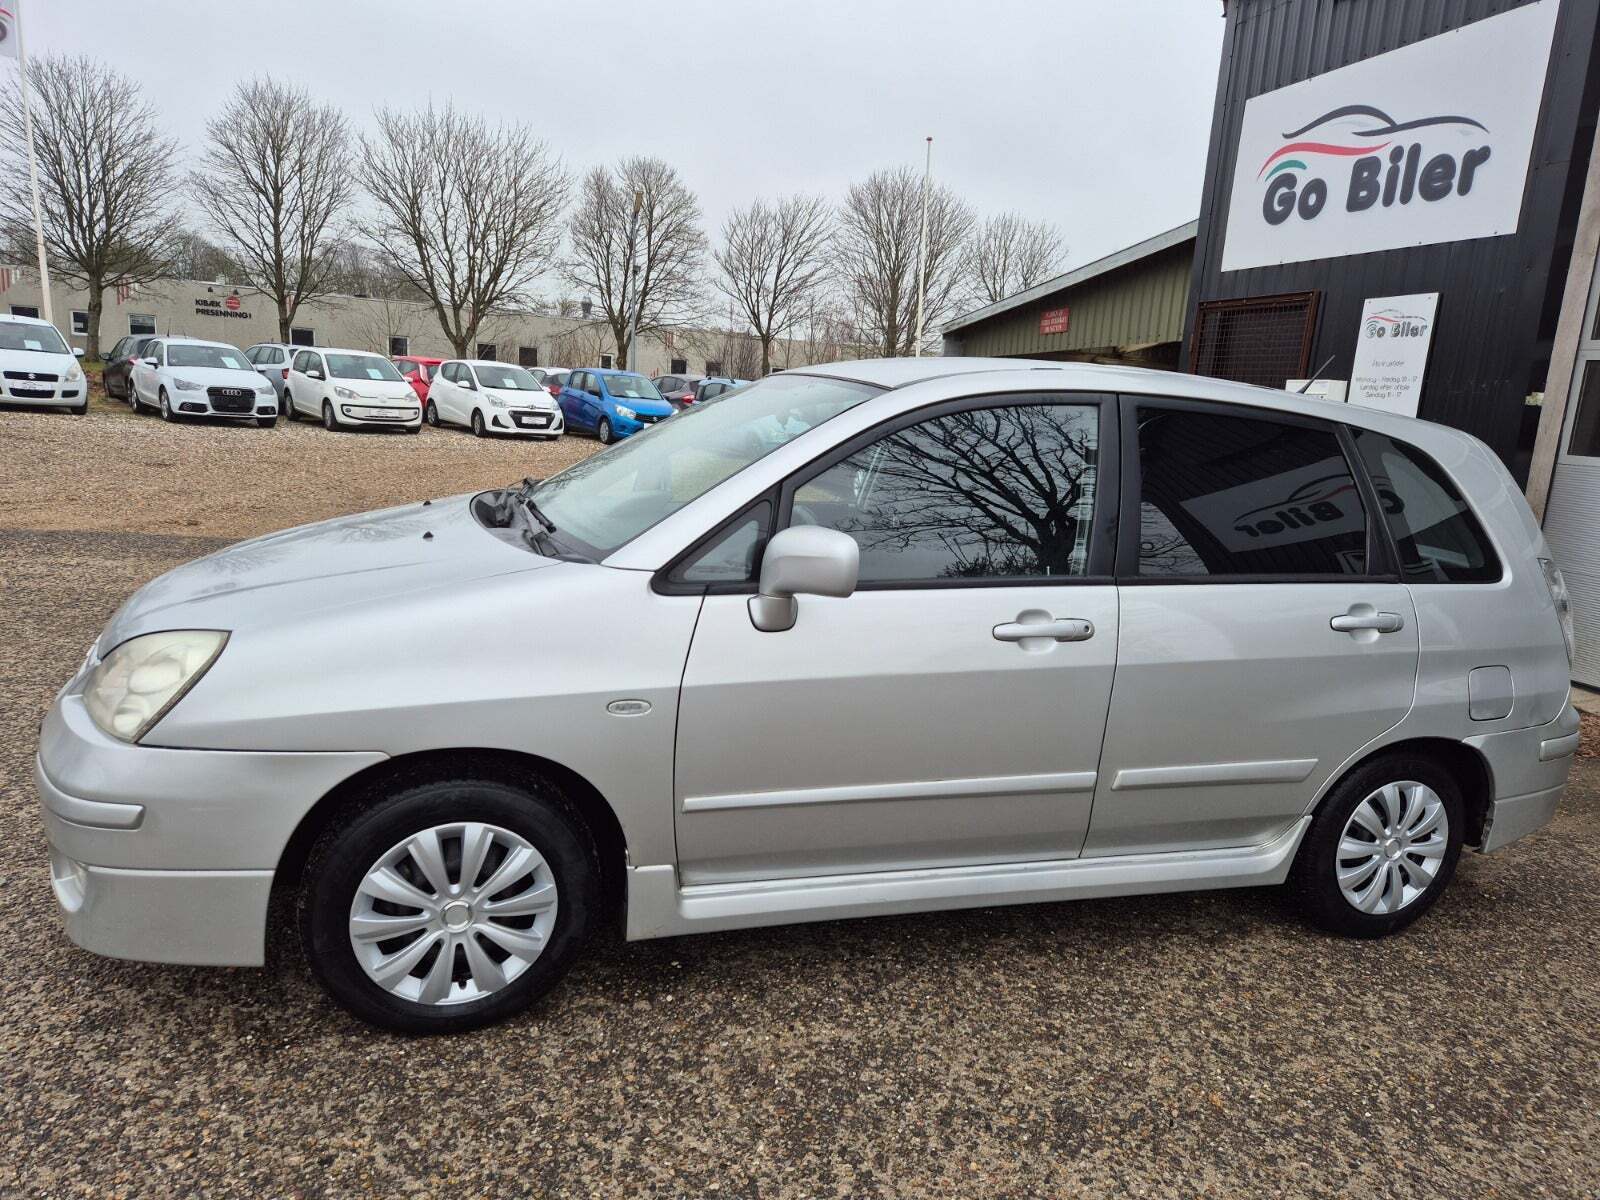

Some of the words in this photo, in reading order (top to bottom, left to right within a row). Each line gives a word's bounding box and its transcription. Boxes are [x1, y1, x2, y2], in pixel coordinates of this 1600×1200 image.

[1262, 171, 1328, 227] Go
[1345, 142, 1492, 214] Biler
[195, 299, 222, 308] KIBÆK
[1366, 323, 1386, 339] Go
[1391, 321, 1428, 338] Biler
